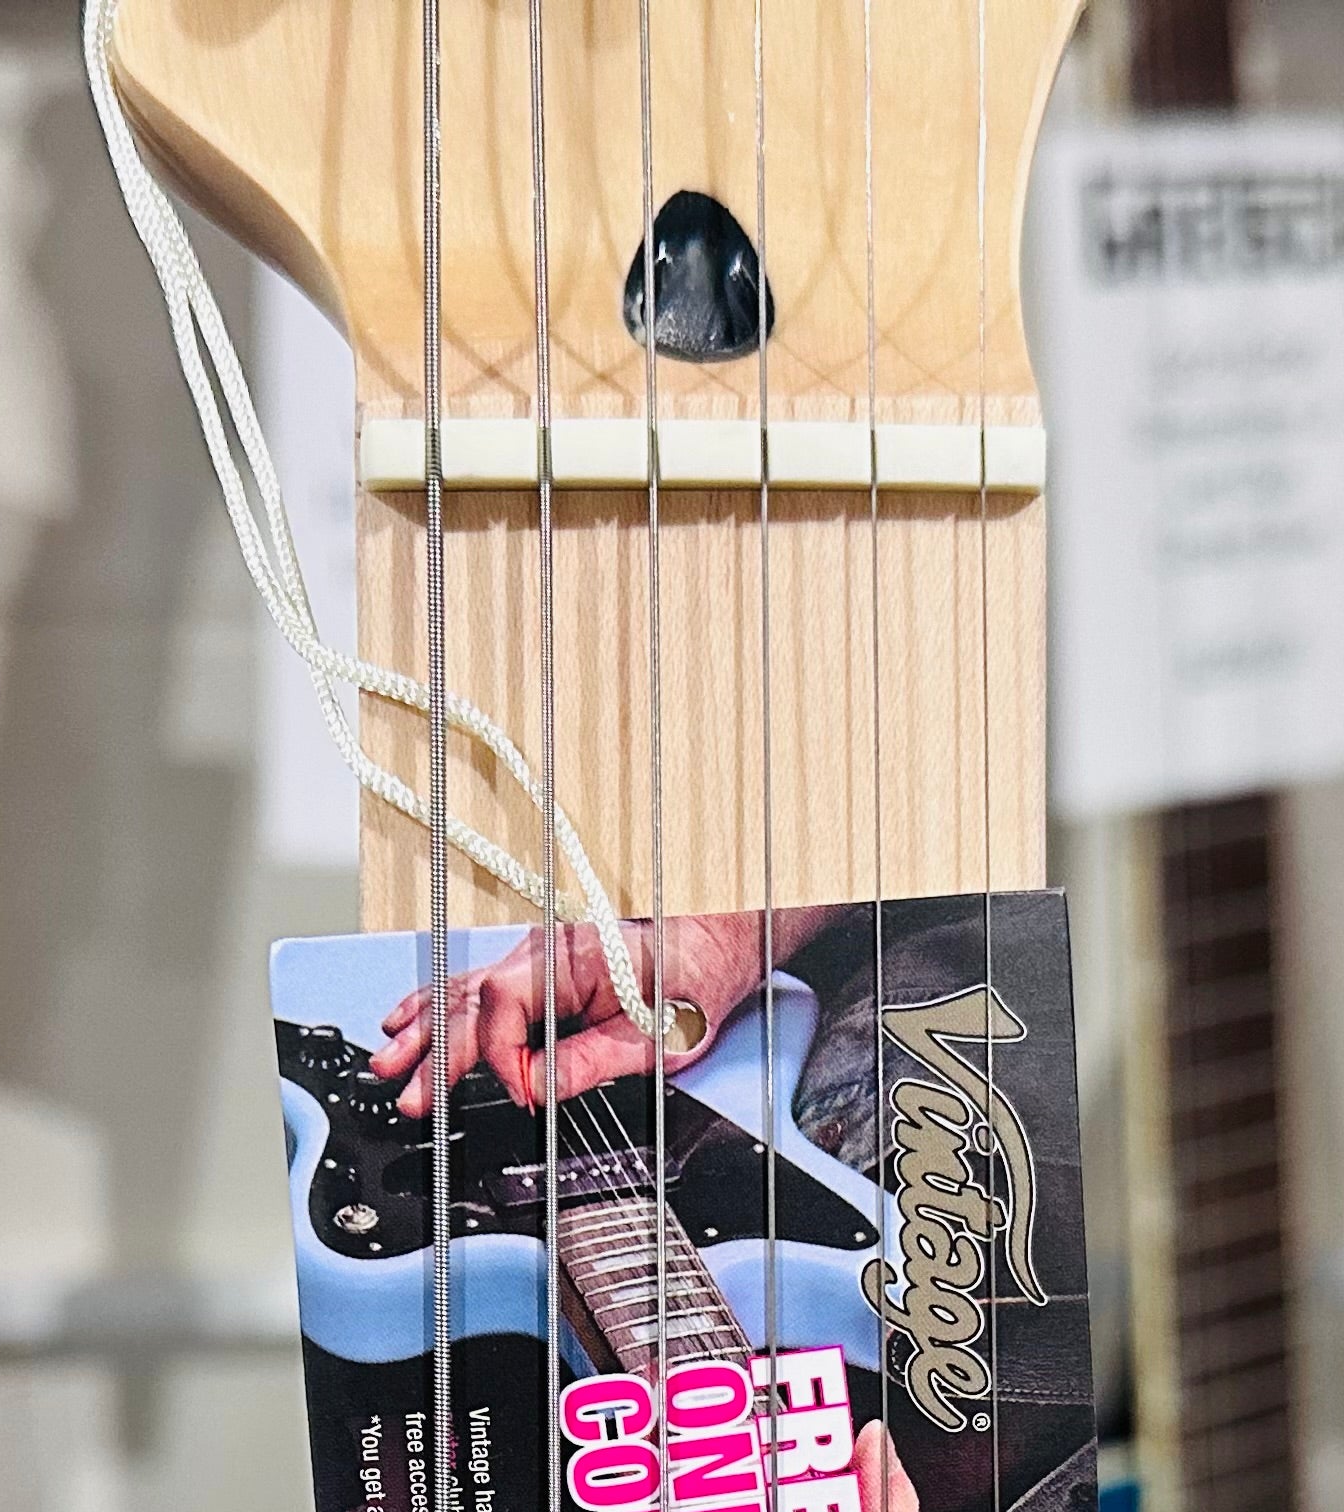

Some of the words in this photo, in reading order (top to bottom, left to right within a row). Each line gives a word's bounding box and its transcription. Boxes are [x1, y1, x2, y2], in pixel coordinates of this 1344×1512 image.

[405, 1412, 426, 1452] free
[468, 1407, 491, 1483] Vintage
[360, 1468, 386, 1501] get
